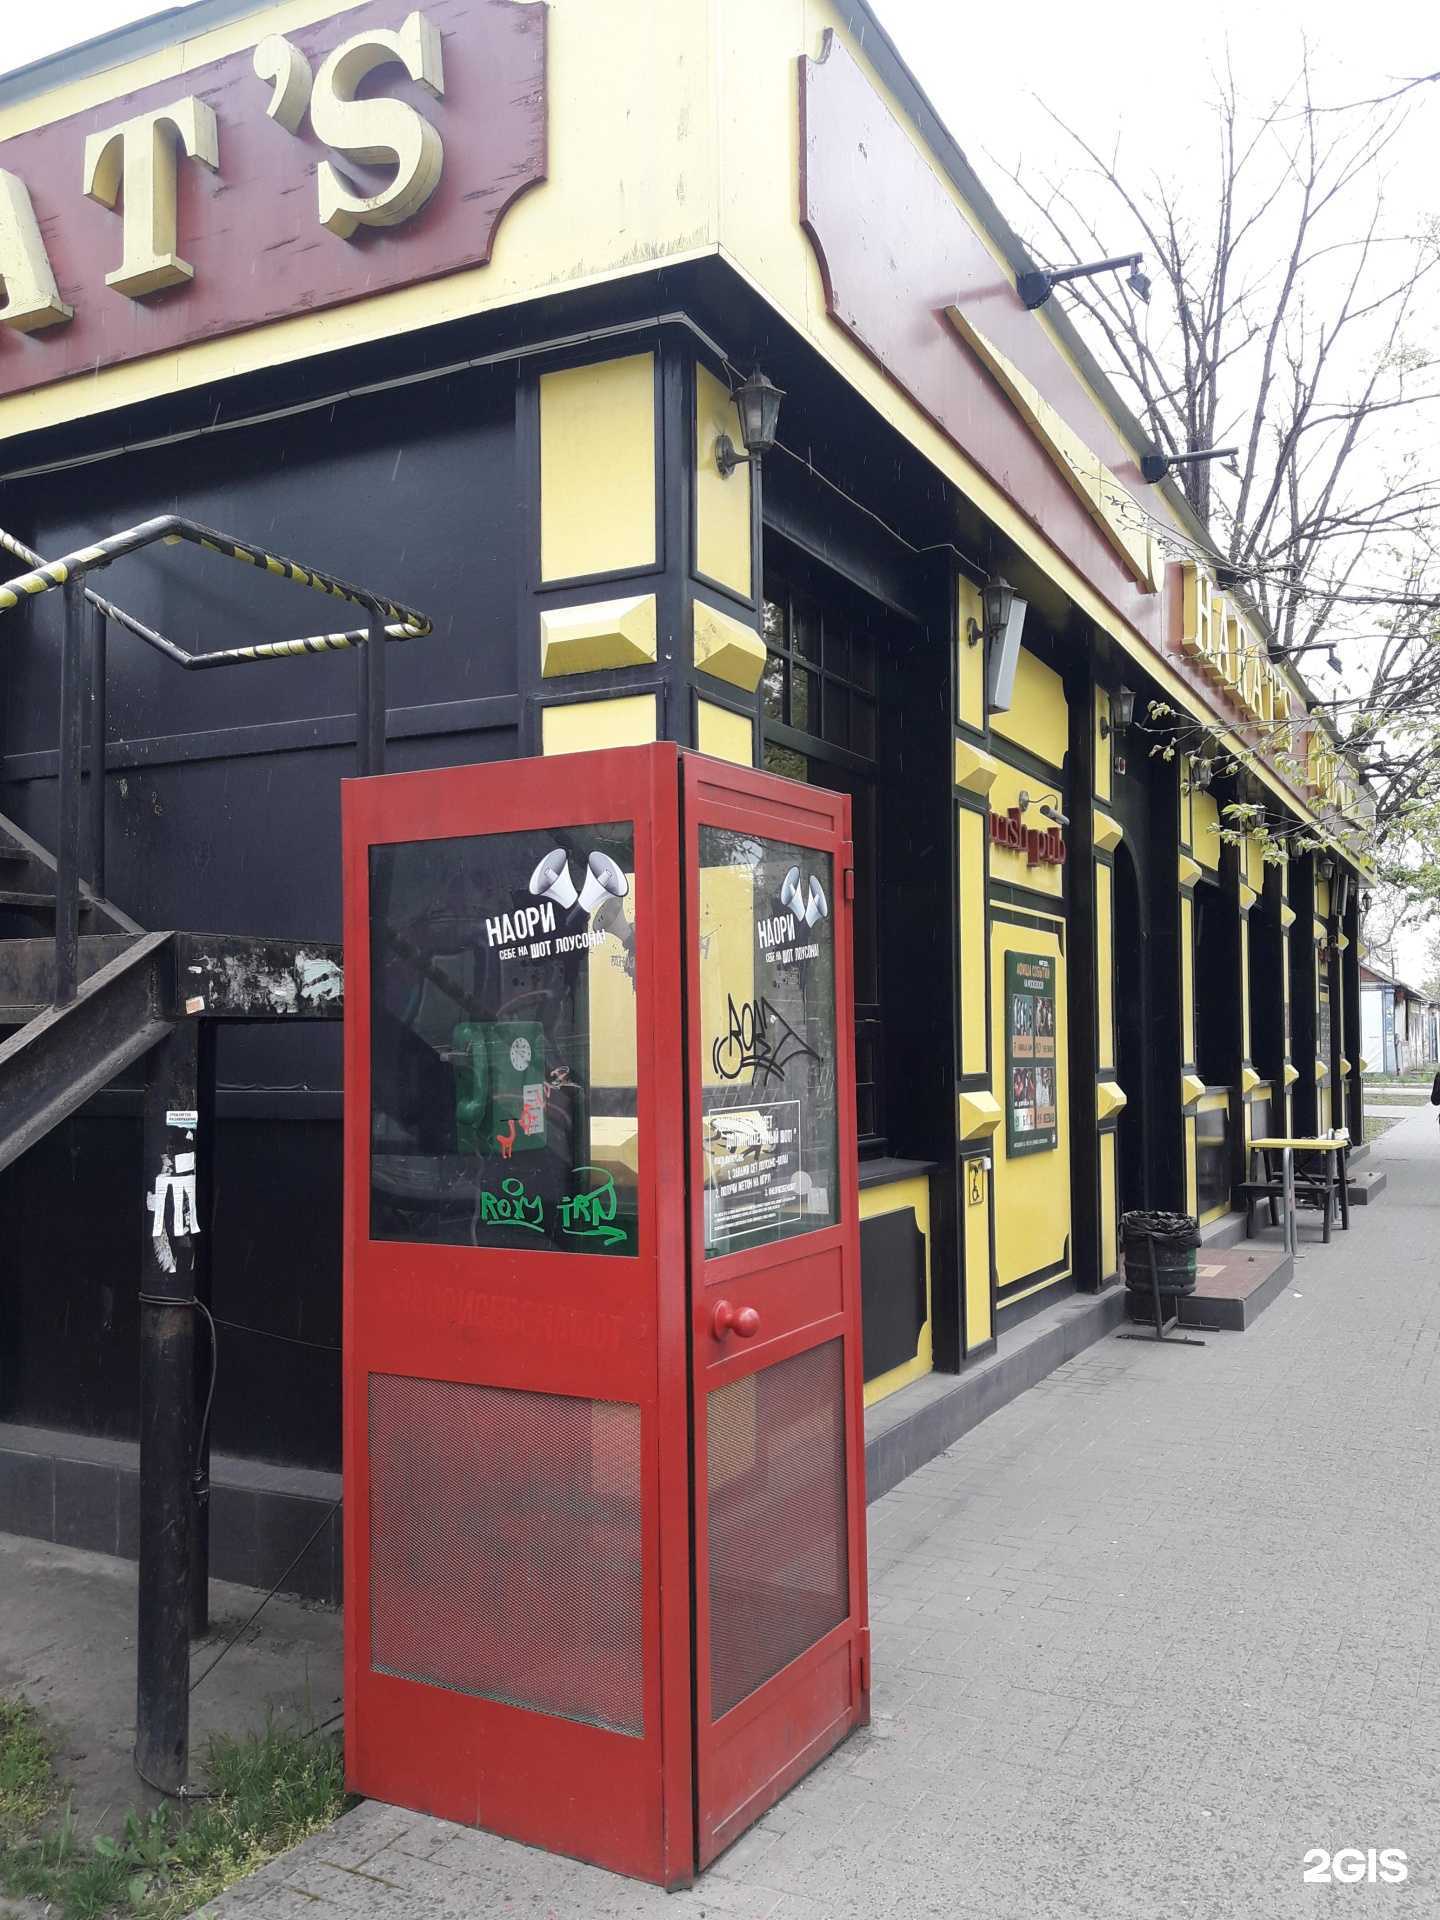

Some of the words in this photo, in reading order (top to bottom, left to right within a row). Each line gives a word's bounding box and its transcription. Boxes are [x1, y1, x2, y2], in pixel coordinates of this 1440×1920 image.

[485, 901, 556, 947] НАОРИ
[758, 913, 795, 949] НАОРИ
[499, 947, 517, 960] СЕБЕ
[518, 945, 528, 957] НА
[530, 940, 551, 959] ШОТ
[782, 948, 793, 964] ШОТ
